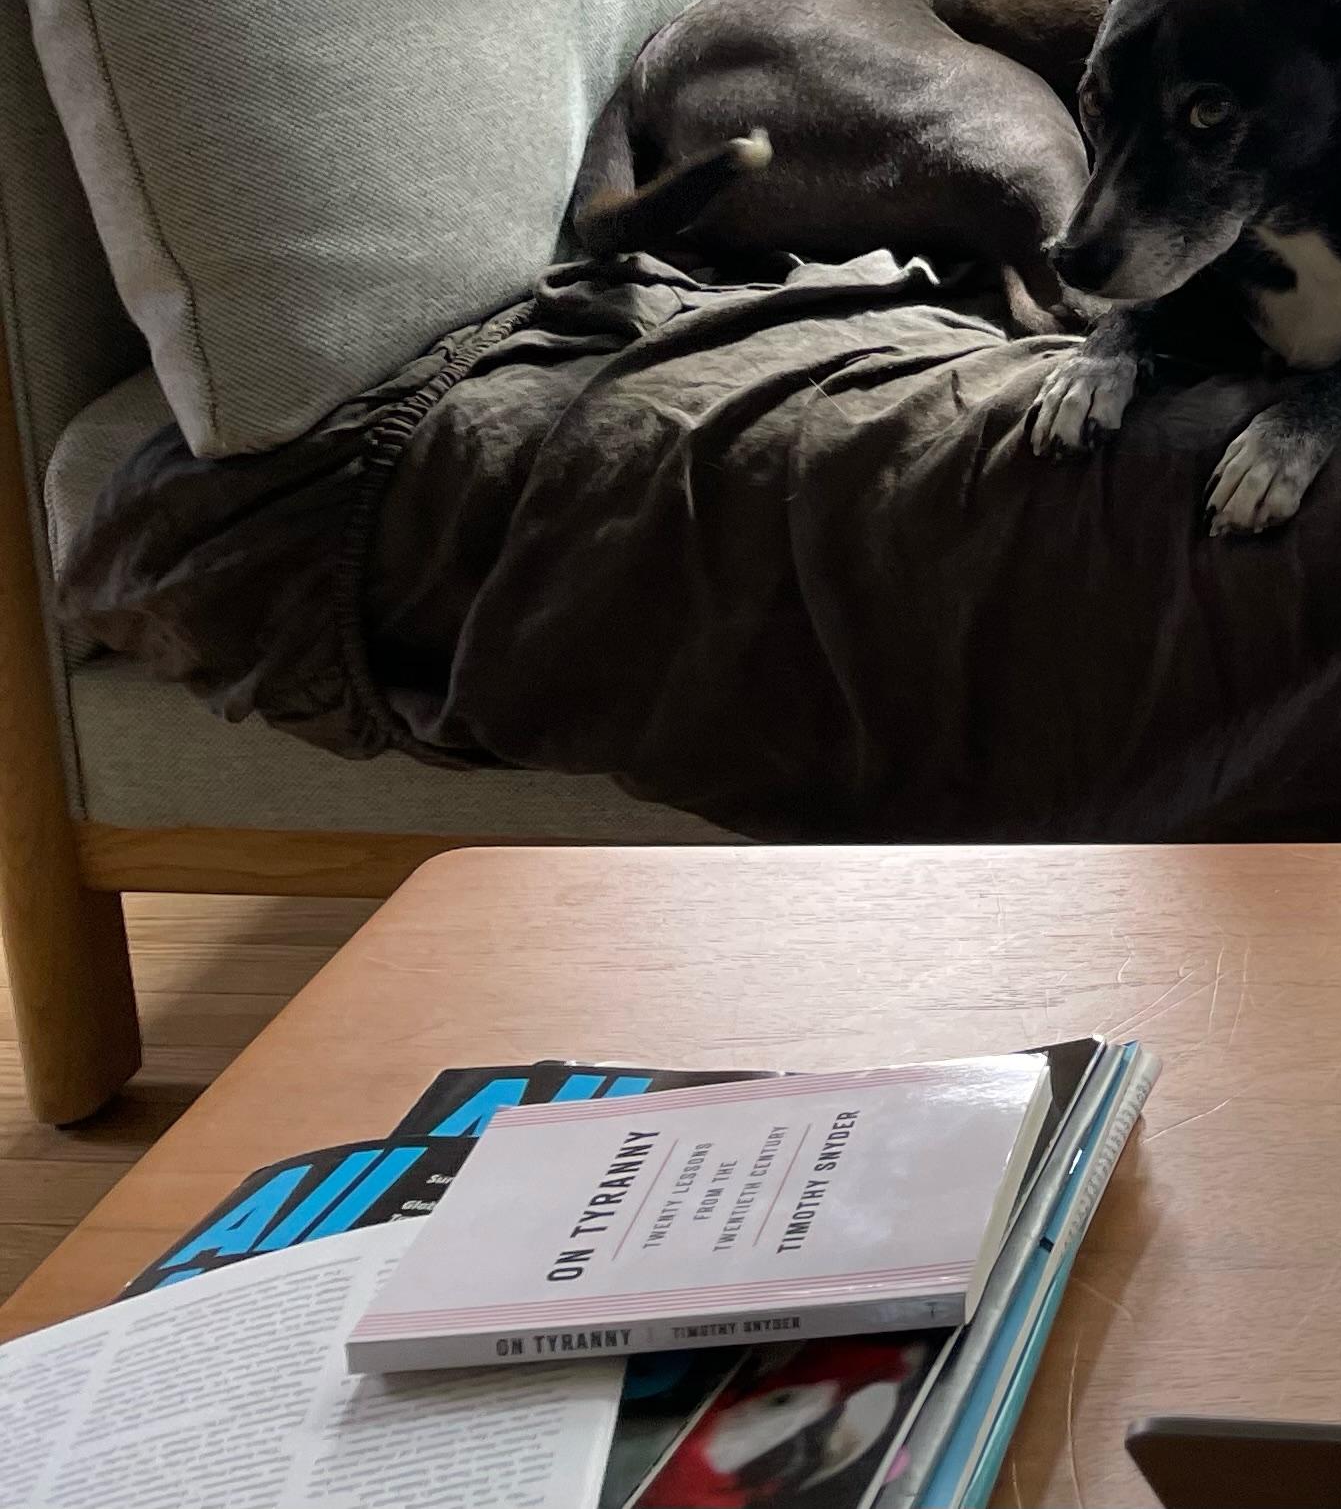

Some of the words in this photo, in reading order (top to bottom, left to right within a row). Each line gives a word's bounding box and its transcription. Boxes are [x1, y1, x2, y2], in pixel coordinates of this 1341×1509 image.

[160, 1146, 428, 1270] All
[569, 1131, 660, 1238] TYRANNY
[642, 1200, 683, 1249] TWENTY
[672, 1142, 714, 1195] LESSONS
[693, 1187, 726, 1221] FROM
[712, 1160, 738, 1183] THE
[712, 1181, 763, 1252] TWENTIETH
[750, 1126, 788, 1177] CENTURY
[776, 1180, 830, 1254] TIMOTHY
[814, 1110, 861, 1171] SNYDER
[546, 1248, 595, 1281] ON
[495, 1337, 524, 1357] ON
[532, 1328, 632, 1355] TYRANNY
[671, 1323, 736, 1339] TIMOTHY
[743, 1316, 801, 1333] SNYDER
